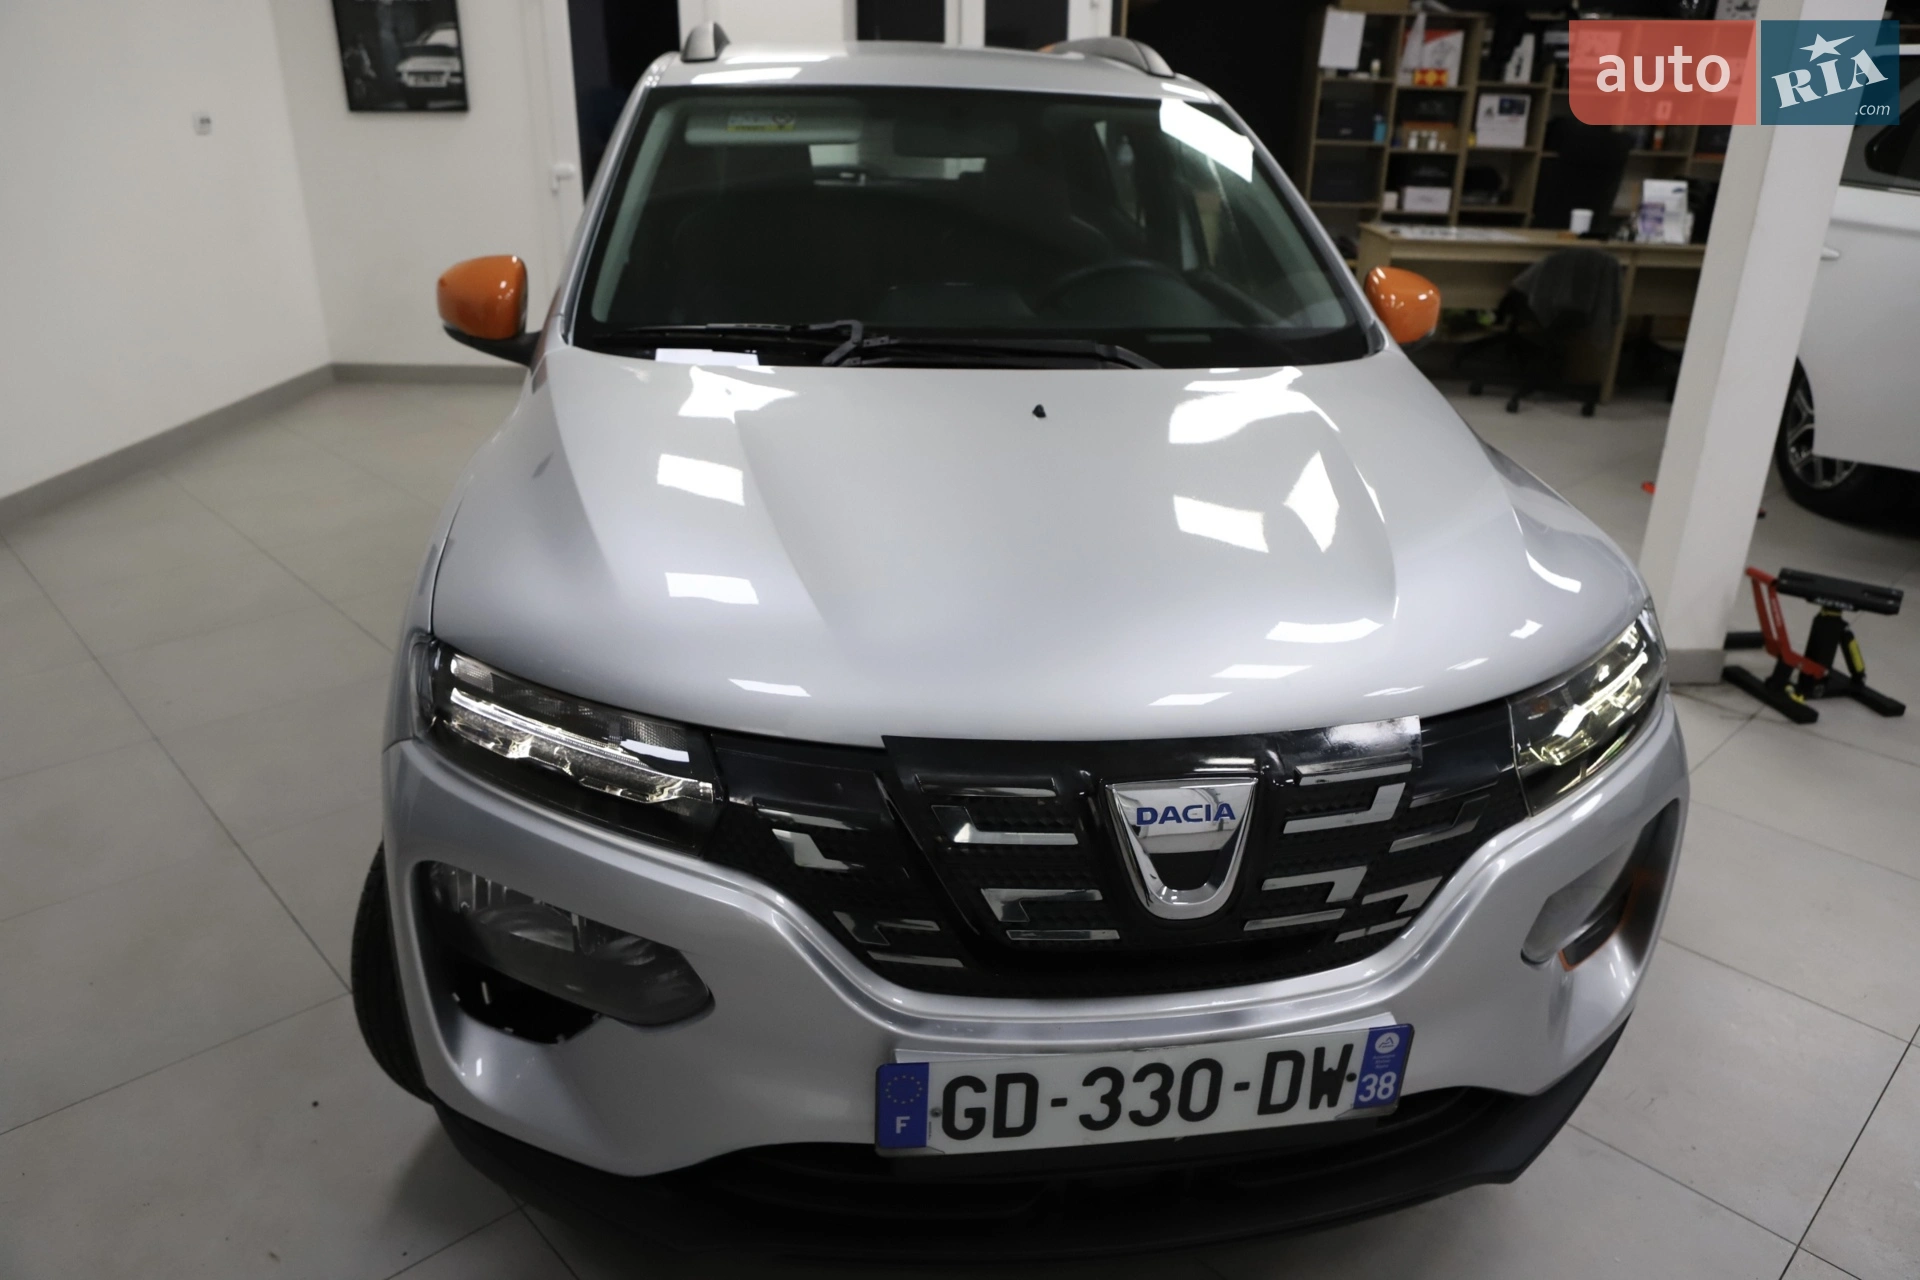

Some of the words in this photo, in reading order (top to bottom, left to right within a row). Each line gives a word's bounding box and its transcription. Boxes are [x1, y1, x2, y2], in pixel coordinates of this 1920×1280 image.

[1136, 803, 1236, 826] DACIA
[942, 1043, 1354, 1141] GD-330-DW
[1358, 1071, 1397, 1102] 38
[895, 1116, 911, 1134] F
